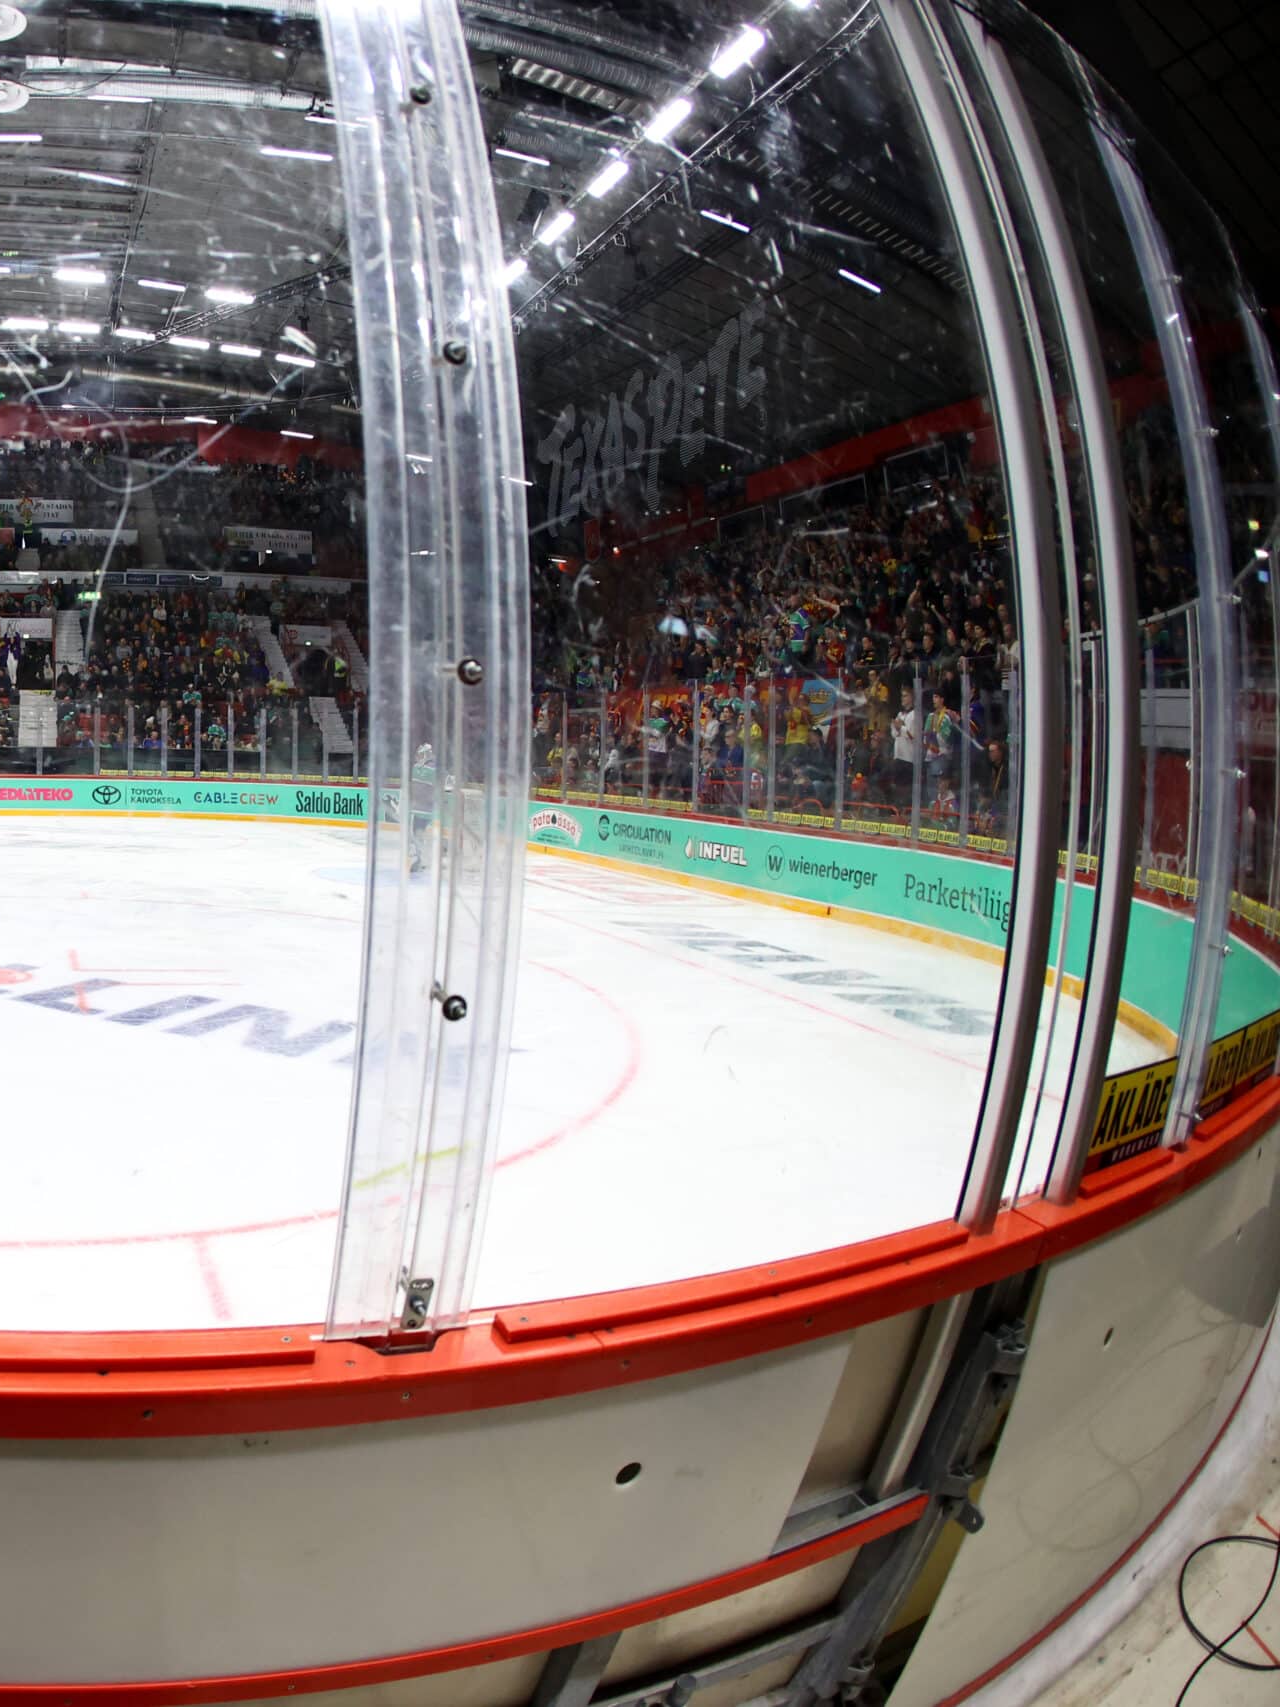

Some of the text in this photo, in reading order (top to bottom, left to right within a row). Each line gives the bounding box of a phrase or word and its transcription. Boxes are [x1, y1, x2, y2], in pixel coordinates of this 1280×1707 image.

[131, 788, 163, 796] TOYOTA
[131, 795, 182, 805] KAIVOKSELA
[193, 791, 279, 805] CABLECREW
[295, 790, 364, 816] Saldo Bank
[612, 822, 672, 845] CIRCULATION
[698, 841, 749, 866] INFUEL
[767, 854, 878, 889] W wienerberger
[903, 872, 1011, 933] Parkettiliig
